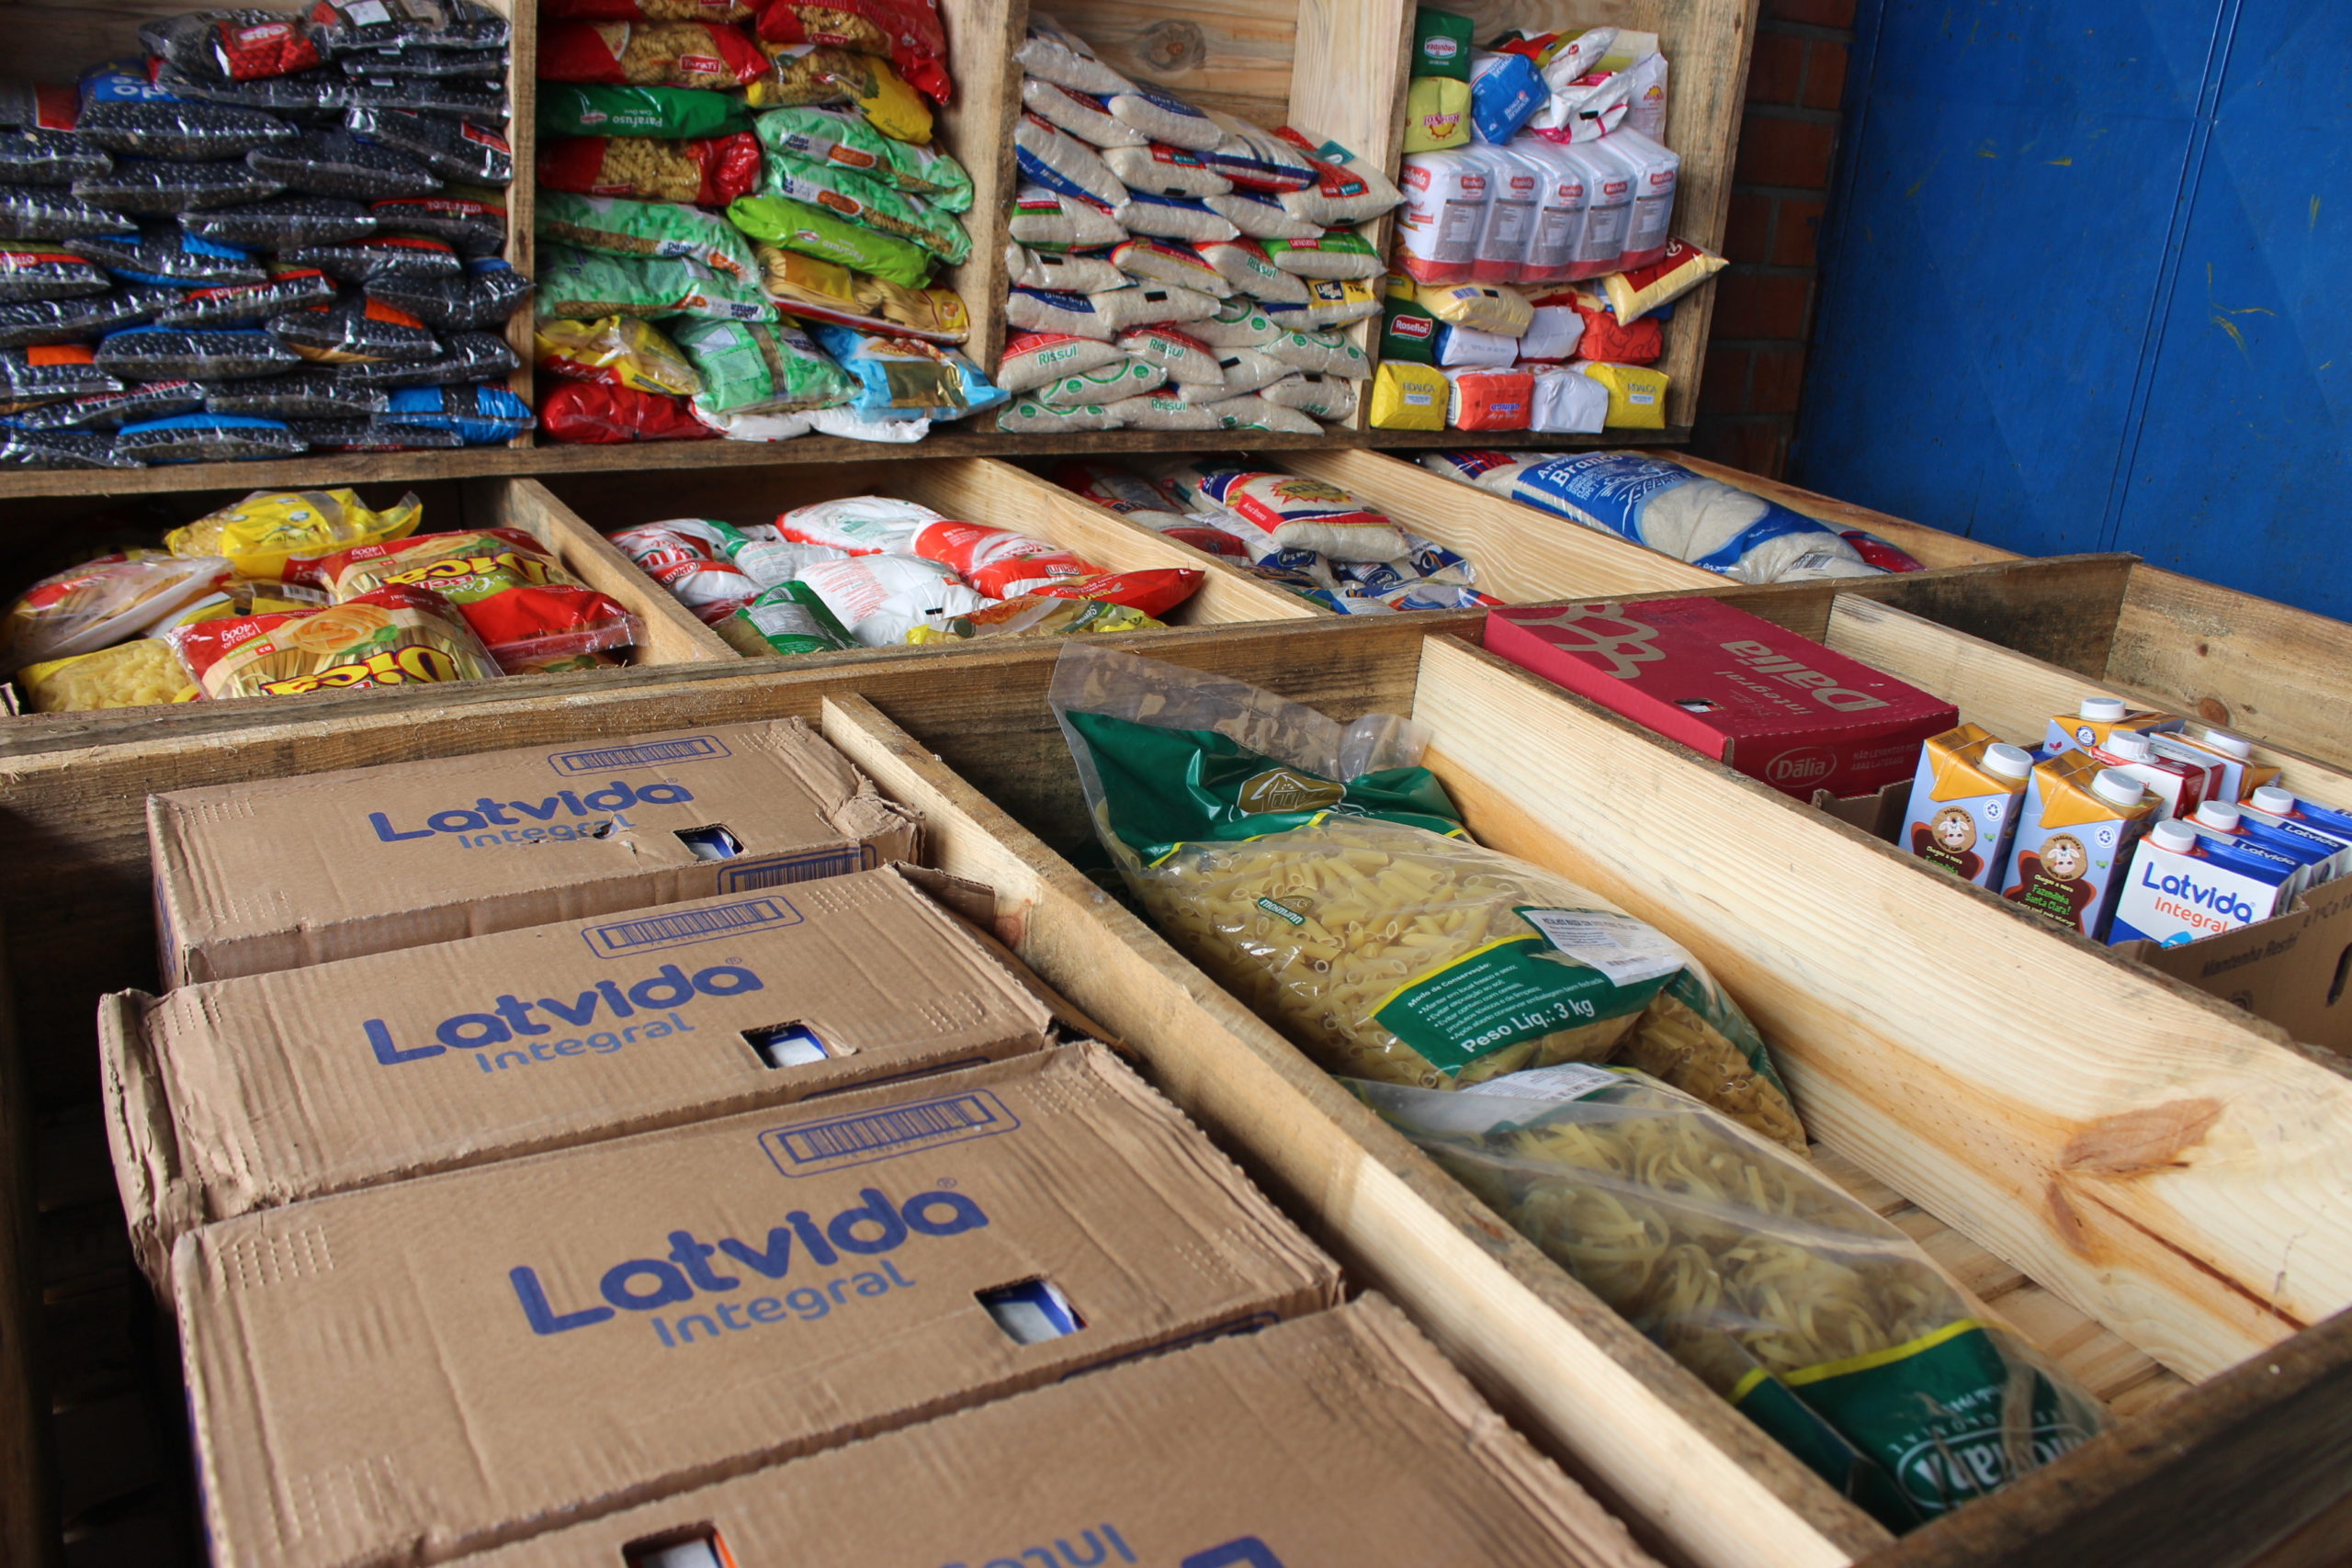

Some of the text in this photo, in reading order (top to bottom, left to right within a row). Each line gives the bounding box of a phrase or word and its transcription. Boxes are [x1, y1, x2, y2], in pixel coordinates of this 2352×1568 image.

[613, 115, 662, 128] Parafuso
[1247, 255, 1278, 279] Rissul
[1038, 345, 1078, 366] Rissul
[1149, 338, 1185, 359] Rissul
[1151, 398, 1187, 412] Rissul
[1548, 453, 1623, 489] Branco
[1720, 639, 1891, 713] Dália
[1776, 752, 1826, 781] Dália
[368, 780, 695, 844] Latvida
[2238, 842, 2297, 866] Latvida
[2284, 825, 2339, 848] Latvida
[2142, 862, 2253, 924] Latvida
[2154, 897, 2228, 934] Integral
[363, 964, 764, 1066] Latvida
[1408, 990, 1430, 1008] Modo
[475, 1012, 695, 1074] Integral
[1460, 1024, 1513, 1054] Peso
[1553, 1001, 1570, 1020] 3
[1566, 998, 1596, 1019] kg
[509, 1188, 989, 1337] Latvida
[650, 1259, 917, 1348] Integral
